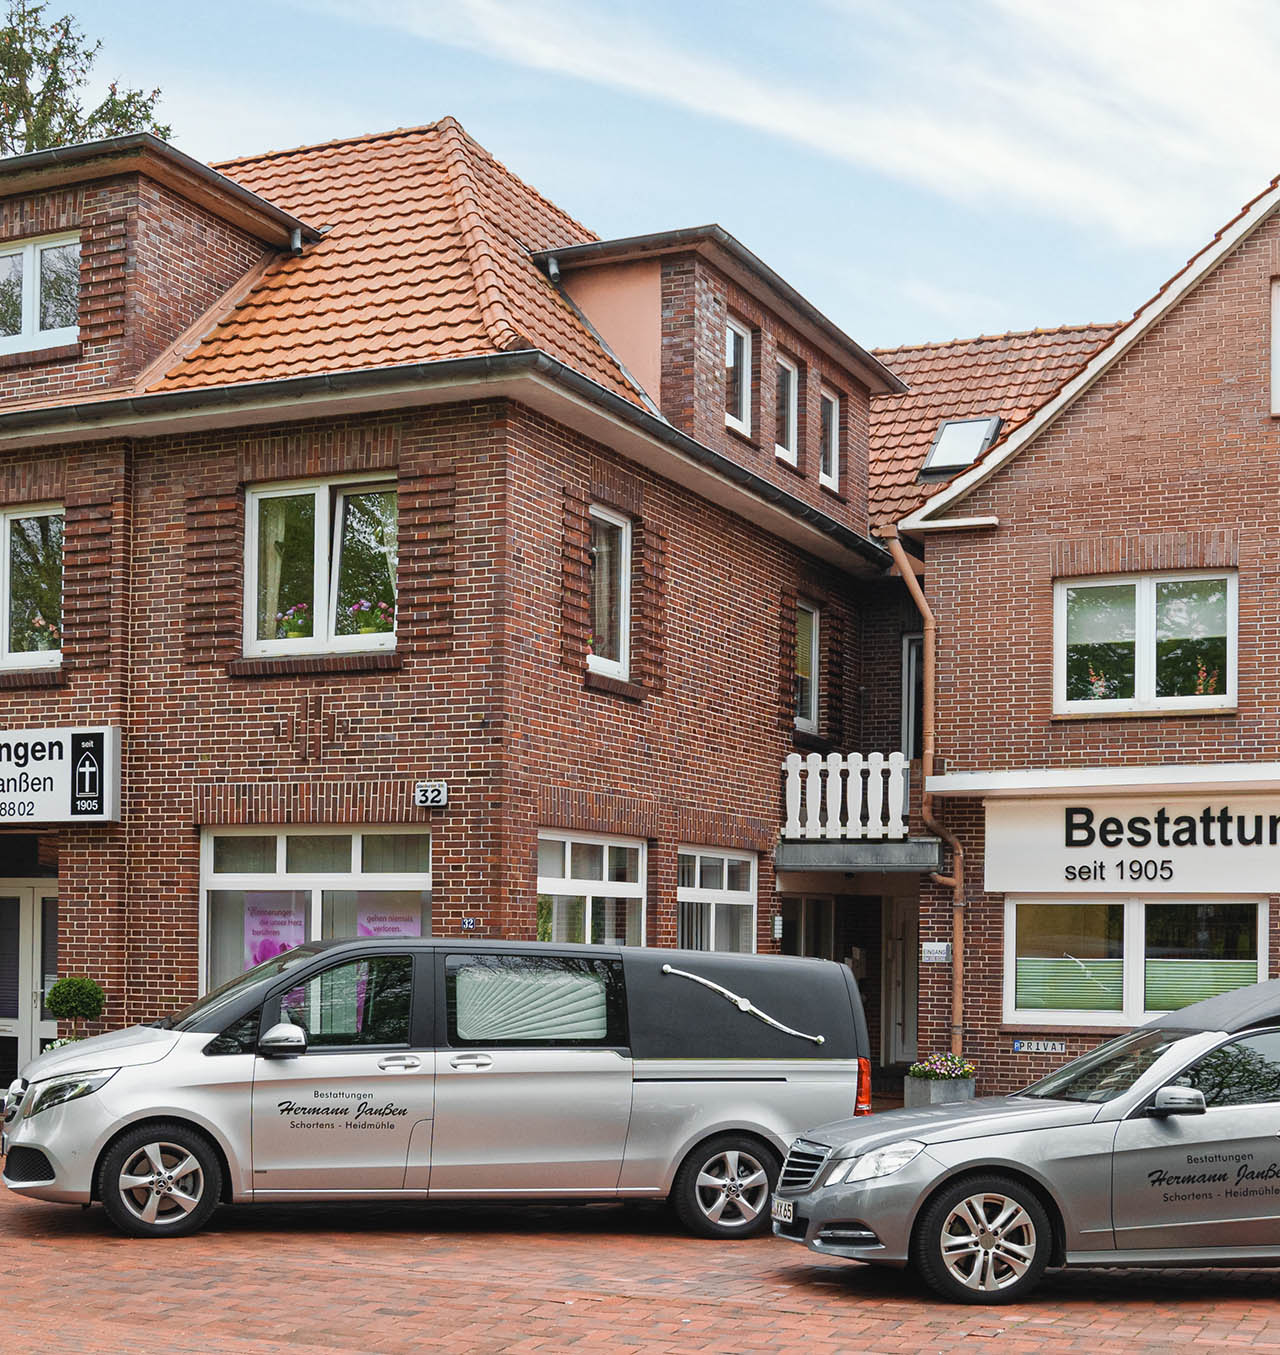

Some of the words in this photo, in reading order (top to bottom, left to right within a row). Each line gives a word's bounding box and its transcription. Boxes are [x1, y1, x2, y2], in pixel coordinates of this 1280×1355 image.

[81, 740, 94, 748] seit
[419, 788, 442, 804] 32
[76, 800, 99, 811] 1905
[1064, 860, 1106, 881] seit
[1115, 859, 1174, 880] 1905
[463, 918, 474, 929] 32
[1019, 1041, 1065, 1051] PRIVAT
[313, 1090, 374, 1100] Bestattungen
[277, 1101, 350, 1116] Hermann
[355, 1101, 408, 1120] Janßen
[289, 1121, 335, 1129] Schortens
[345, 1121, 395, 1130] Heidmühle
[1187, 1153, 1254, 1165] Bestattungen
[1148, 1169, 1229, 1187] Hermann
[1162, 1191, 1213, 1202] Schortens
[1224, 1186, 1280, 1198] Heidmühle
[783, 1202, 792, 1220] 65
